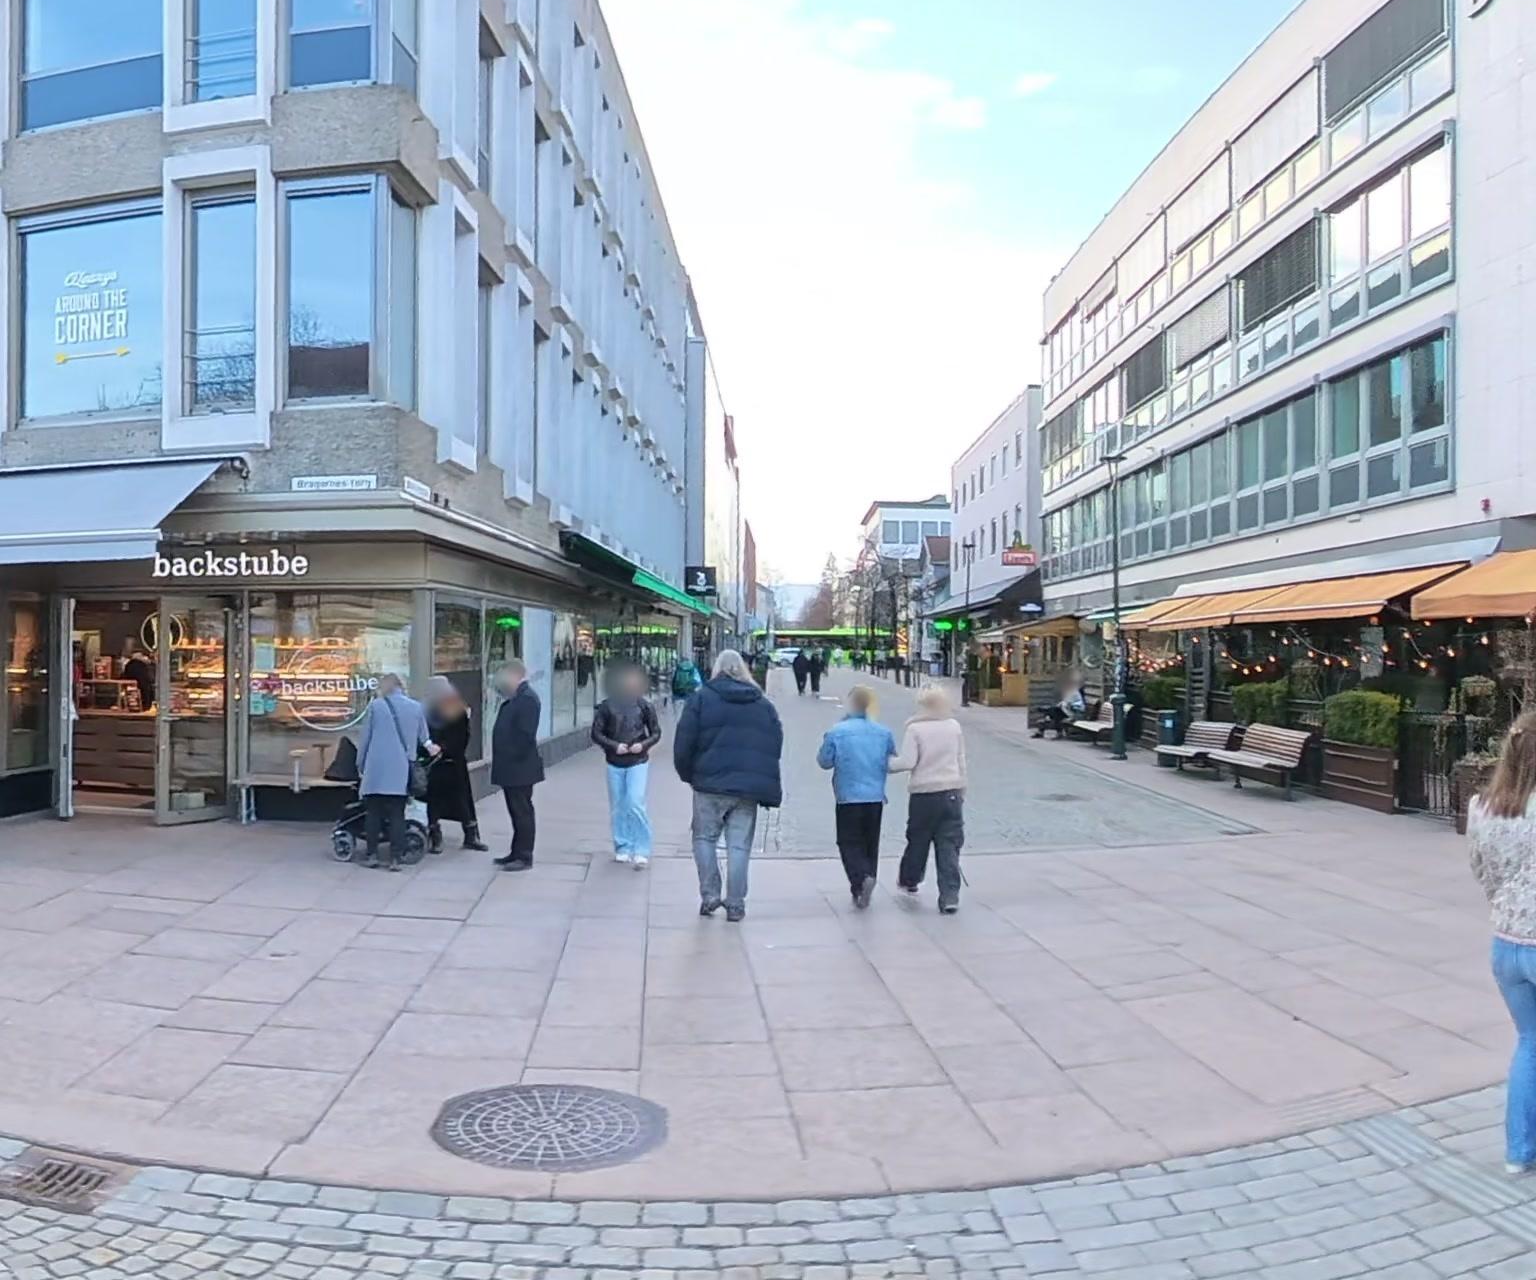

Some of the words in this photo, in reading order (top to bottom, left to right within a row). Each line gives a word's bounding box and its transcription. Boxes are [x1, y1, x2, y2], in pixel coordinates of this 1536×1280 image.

[55, 293, 99, 314] AROUND
[103, 288, 128, 308] THE
[55, 309, 128, 344] CORNER
[152, 549, 309, 577] backstube
[281, 675, 379, 696] backstube
